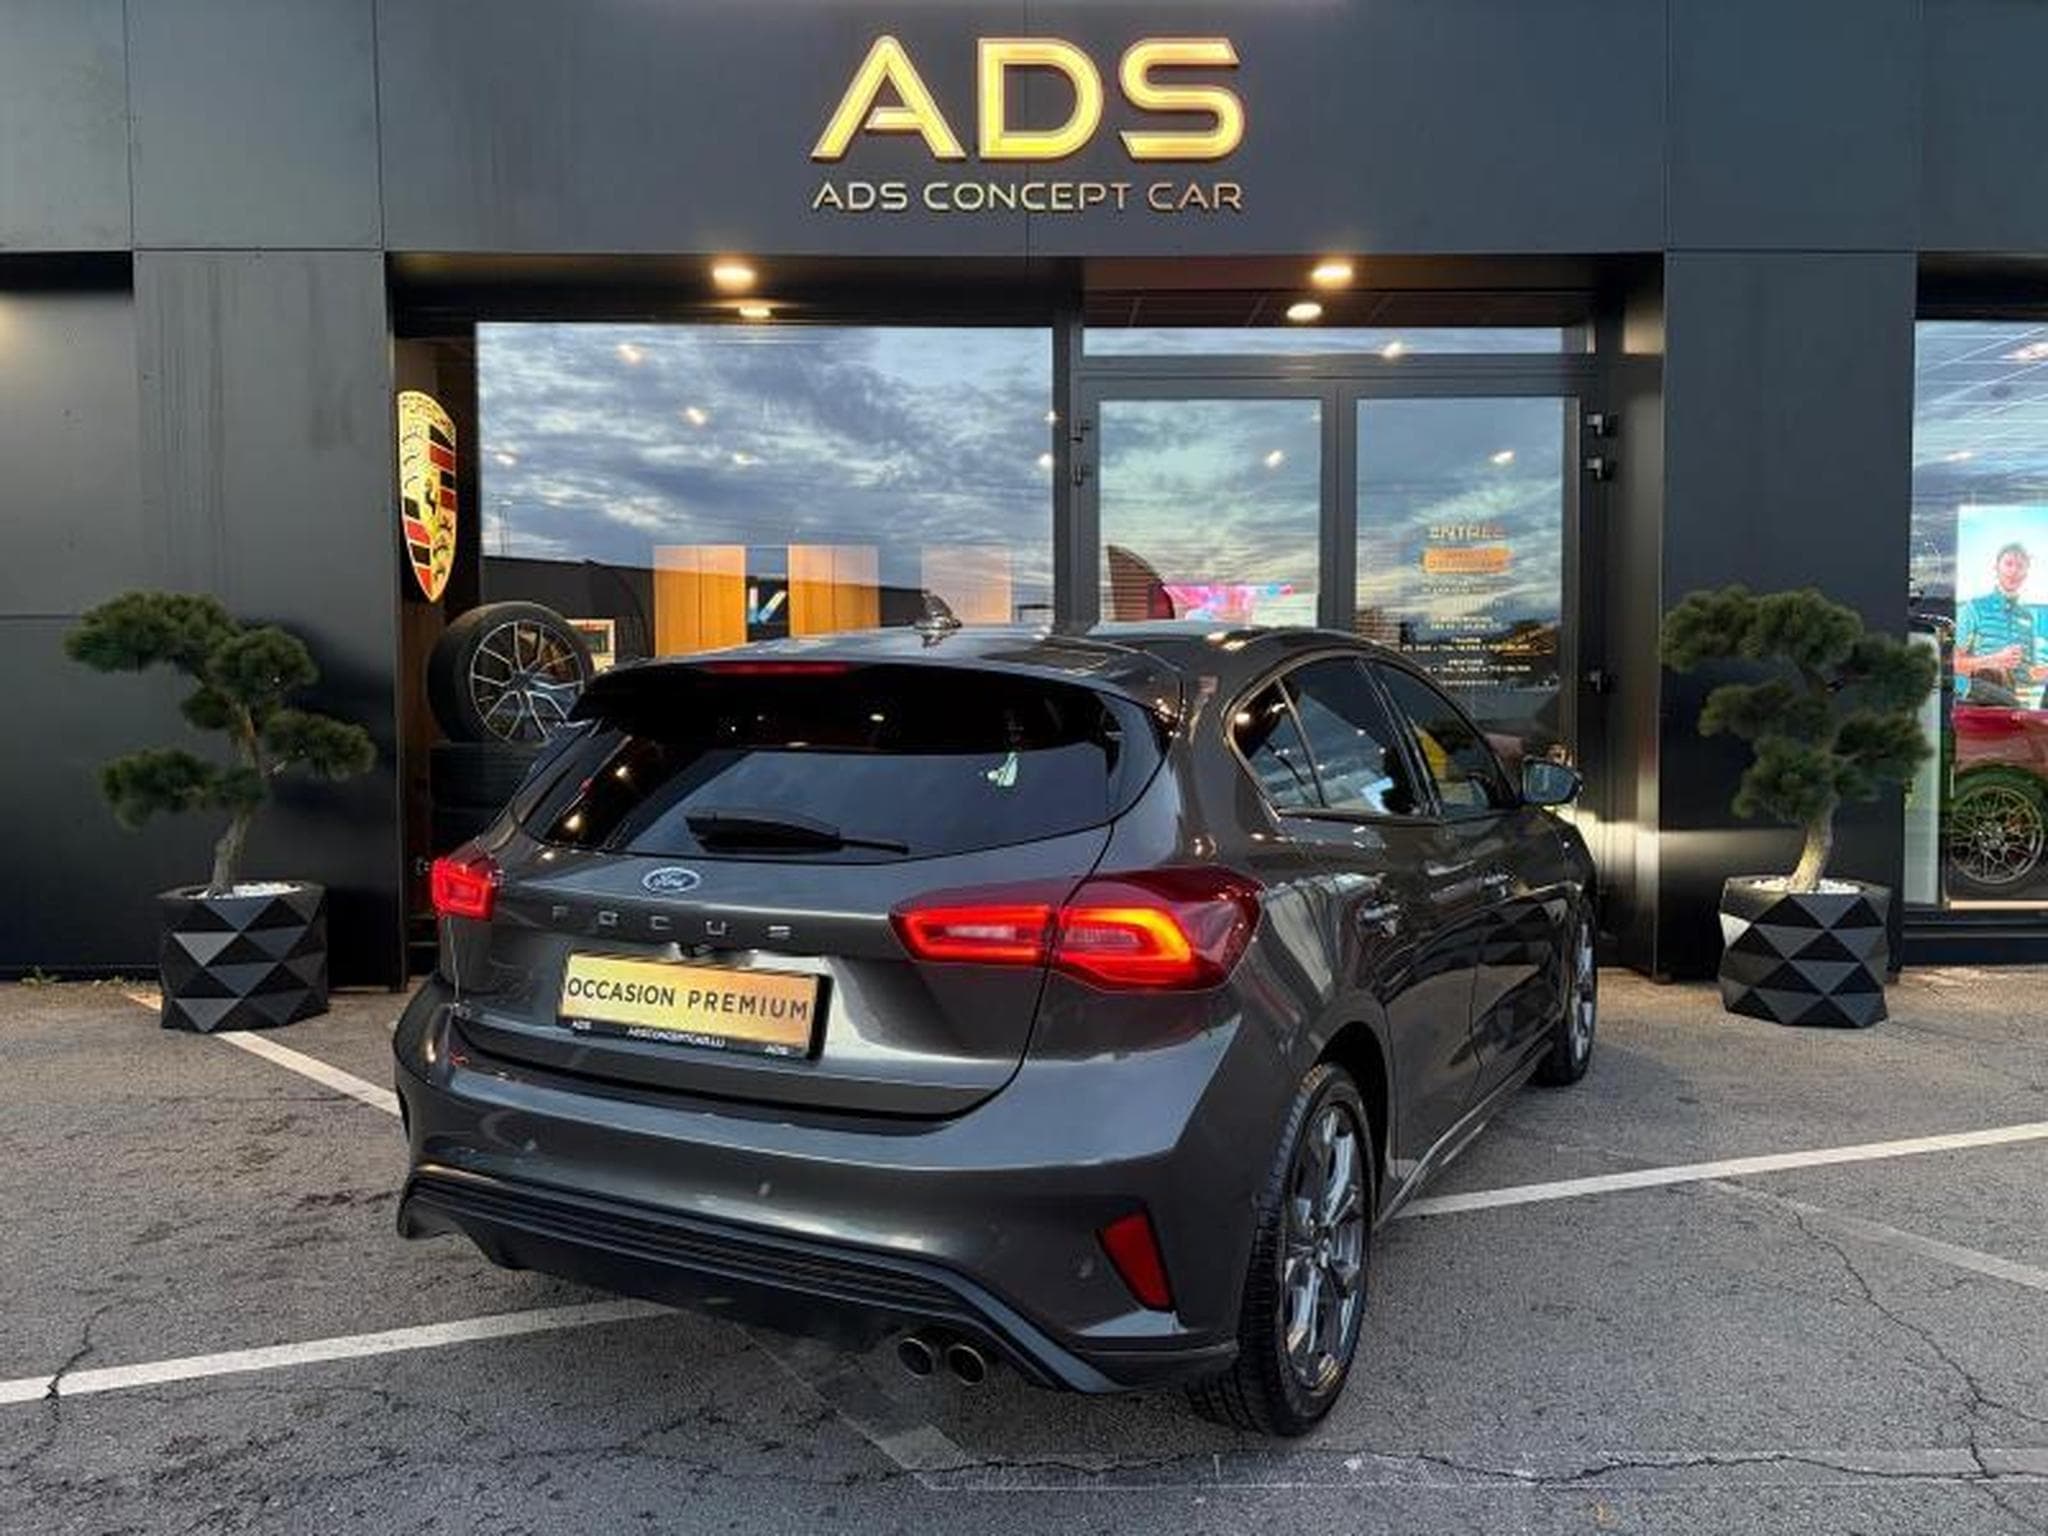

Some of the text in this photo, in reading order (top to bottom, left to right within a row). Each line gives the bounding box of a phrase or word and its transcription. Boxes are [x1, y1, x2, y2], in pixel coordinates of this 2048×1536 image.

[810, 34, 1245, 161] ADS
[811, 181, 1244, 211] ADS CONCEPT CAR
[552, 905, 792, 940] FOCUS
[567, 976, 809, 1020] OCCASION PREMIUM
